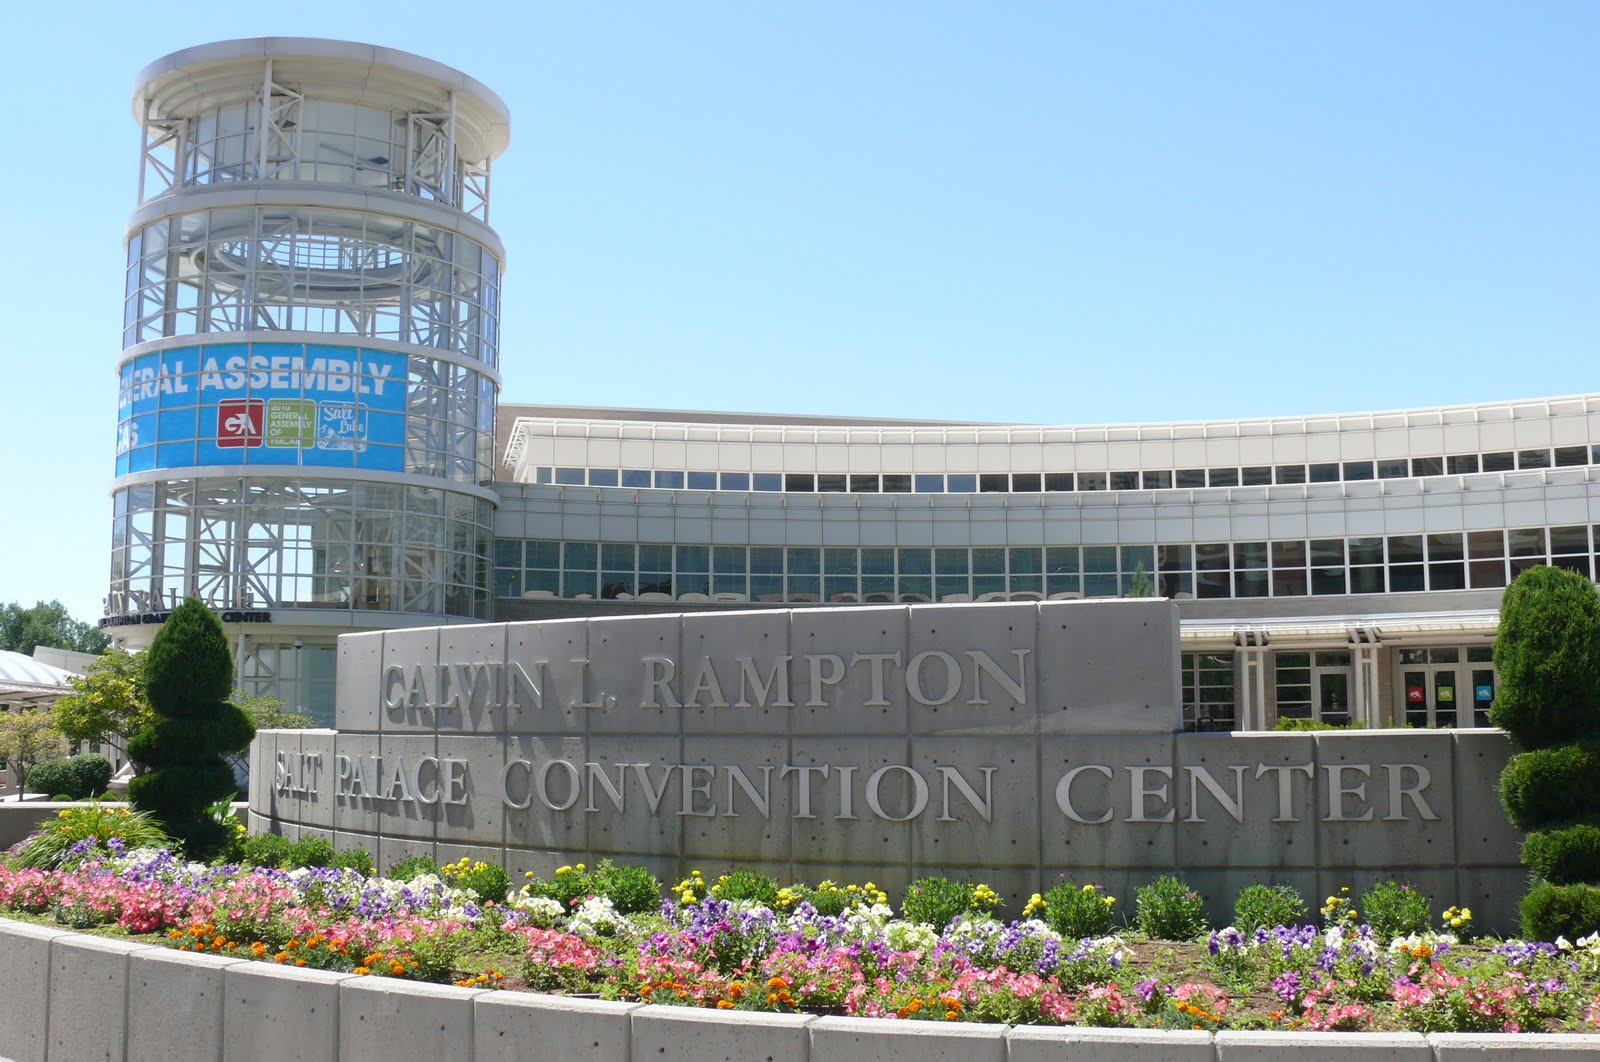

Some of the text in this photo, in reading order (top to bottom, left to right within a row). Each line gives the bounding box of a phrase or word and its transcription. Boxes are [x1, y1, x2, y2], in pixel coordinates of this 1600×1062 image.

[197, 355, 392, 396] ASSEMBLY
[270, 411, 309, 420] GENERL
[270, 420, 312, 428] ASSEMLY
[270, 428, 283, 436] OF
[221, 611, 272, 623] CENTER
[382, 648, 1032, 710] CALVIN L. RAMPTON
[275, 751, 1441, 824] SALT PALACE CONVENTION CENTER
